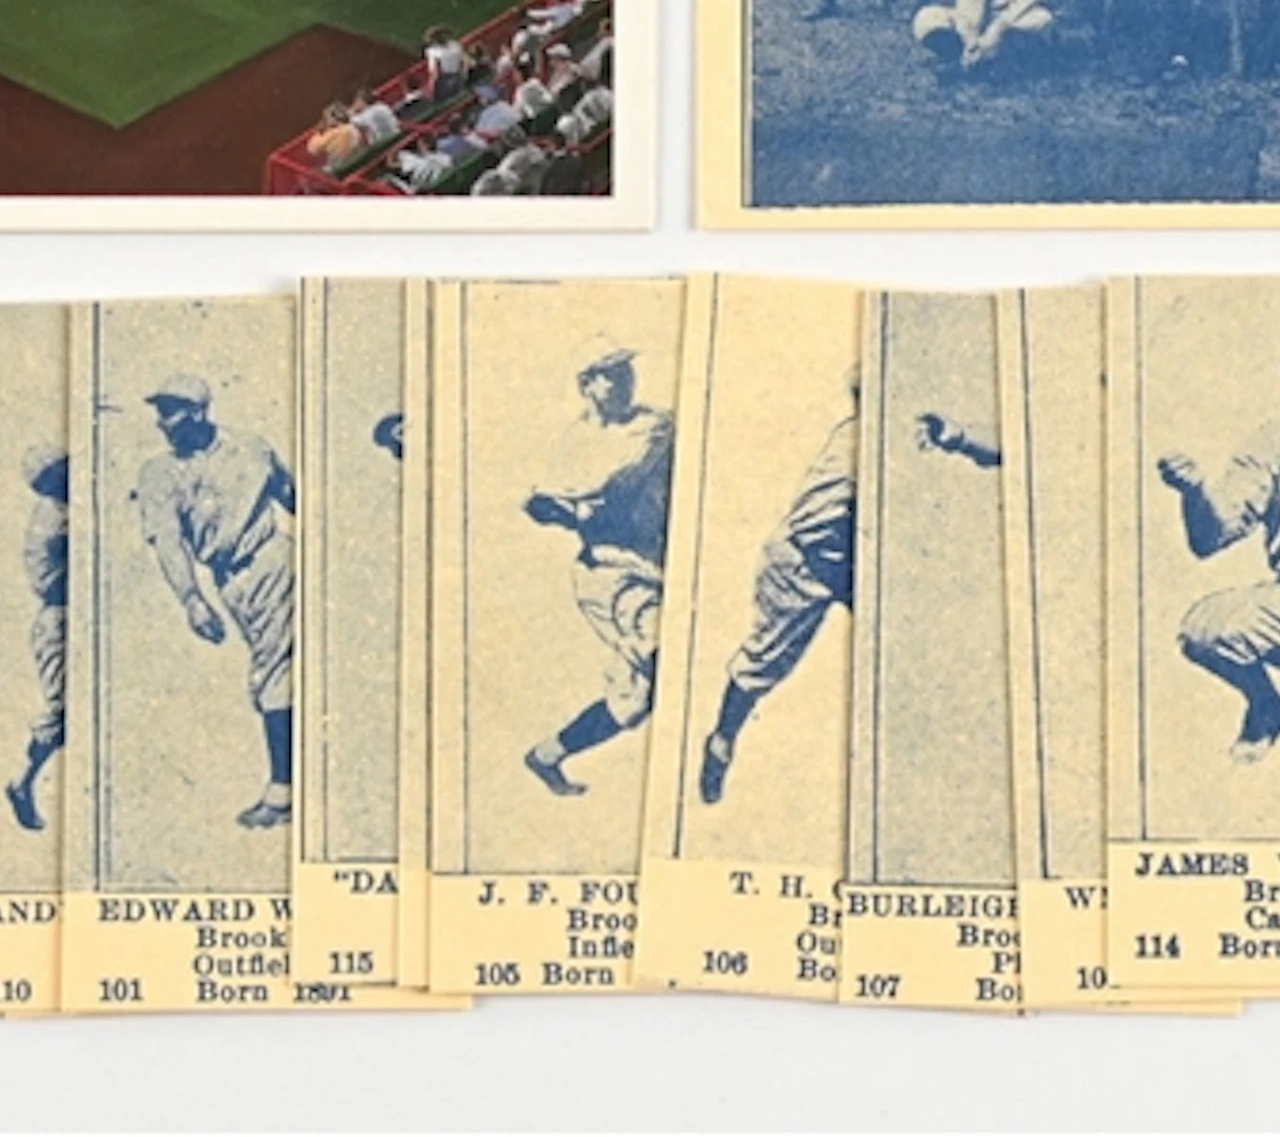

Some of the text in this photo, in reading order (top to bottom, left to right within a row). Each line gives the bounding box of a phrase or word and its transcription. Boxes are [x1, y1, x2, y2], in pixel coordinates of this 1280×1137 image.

[1134, 852, 1250, 878] JAMES
[477, 880, 506, 906] J.
[527, 881, 558, 905] F.
[729, 870, 760, 895] T.
[779, 874, 813, 899] H.
[98, 898, 256, 923] EDWARD
[566, 907, 639, 934] Broo
[195, 925, 289, 952] Brook
[568, 934, 635, 961] Infie
[1135, 934, 1181, 959] 114
[192, 952, 291, 979] Outfiel
[329, 951, 374, 975] 115
[475, 962, 615, 987] 105 Born
[703, 950, 839, 983] 106 Bo
[99, 977, 143, 1002] 101
[196, 976, 269, 1004] Born
[855, 973, 901, 999] 107
